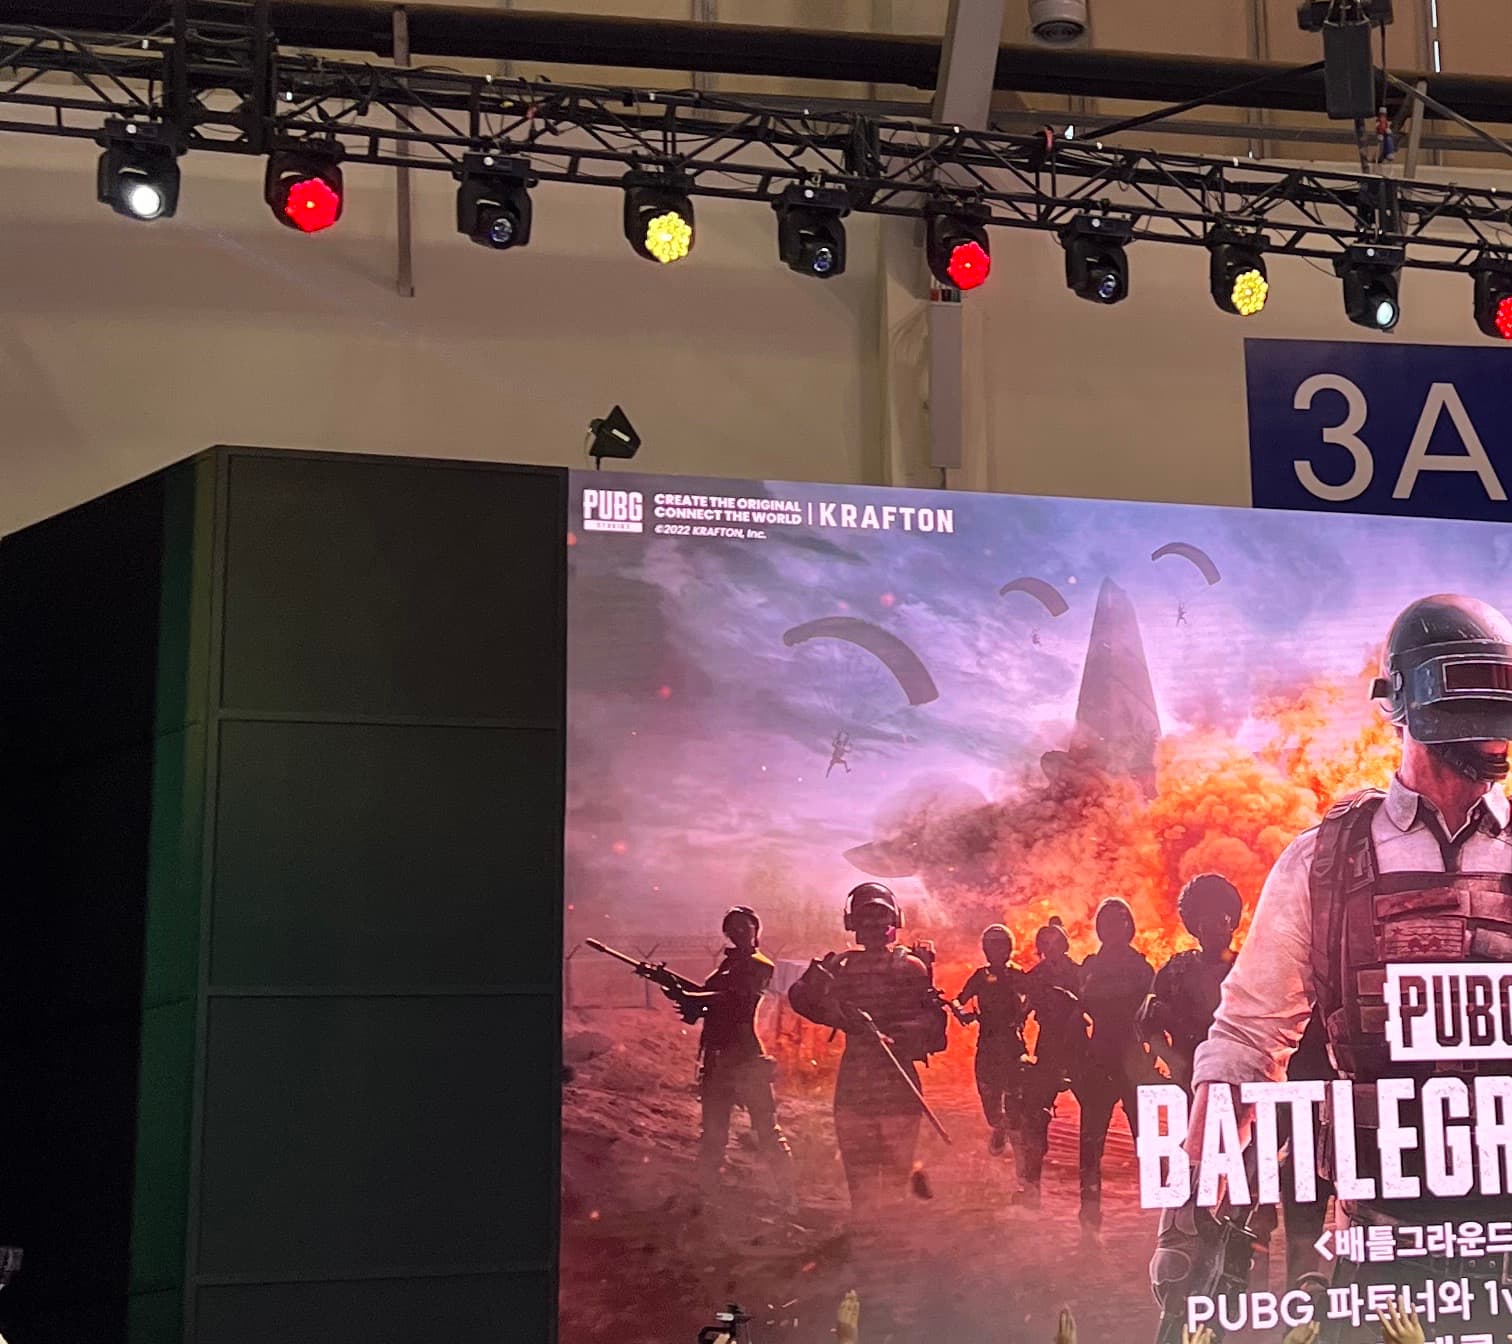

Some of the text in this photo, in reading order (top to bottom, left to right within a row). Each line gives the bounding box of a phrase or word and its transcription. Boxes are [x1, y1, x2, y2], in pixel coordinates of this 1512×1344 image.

[1293, 373, 1508, 502] 3A
[583, 489, 643, 522] PUBG
[654, 493, 802, 512] CREATE THE ORIGINAL
[654, 507, 802, 525] CONNECT THE WORLD
[820, 502, 953, 533] KRAFTON
[1187, 1290, 1314, 1333] PUBG
